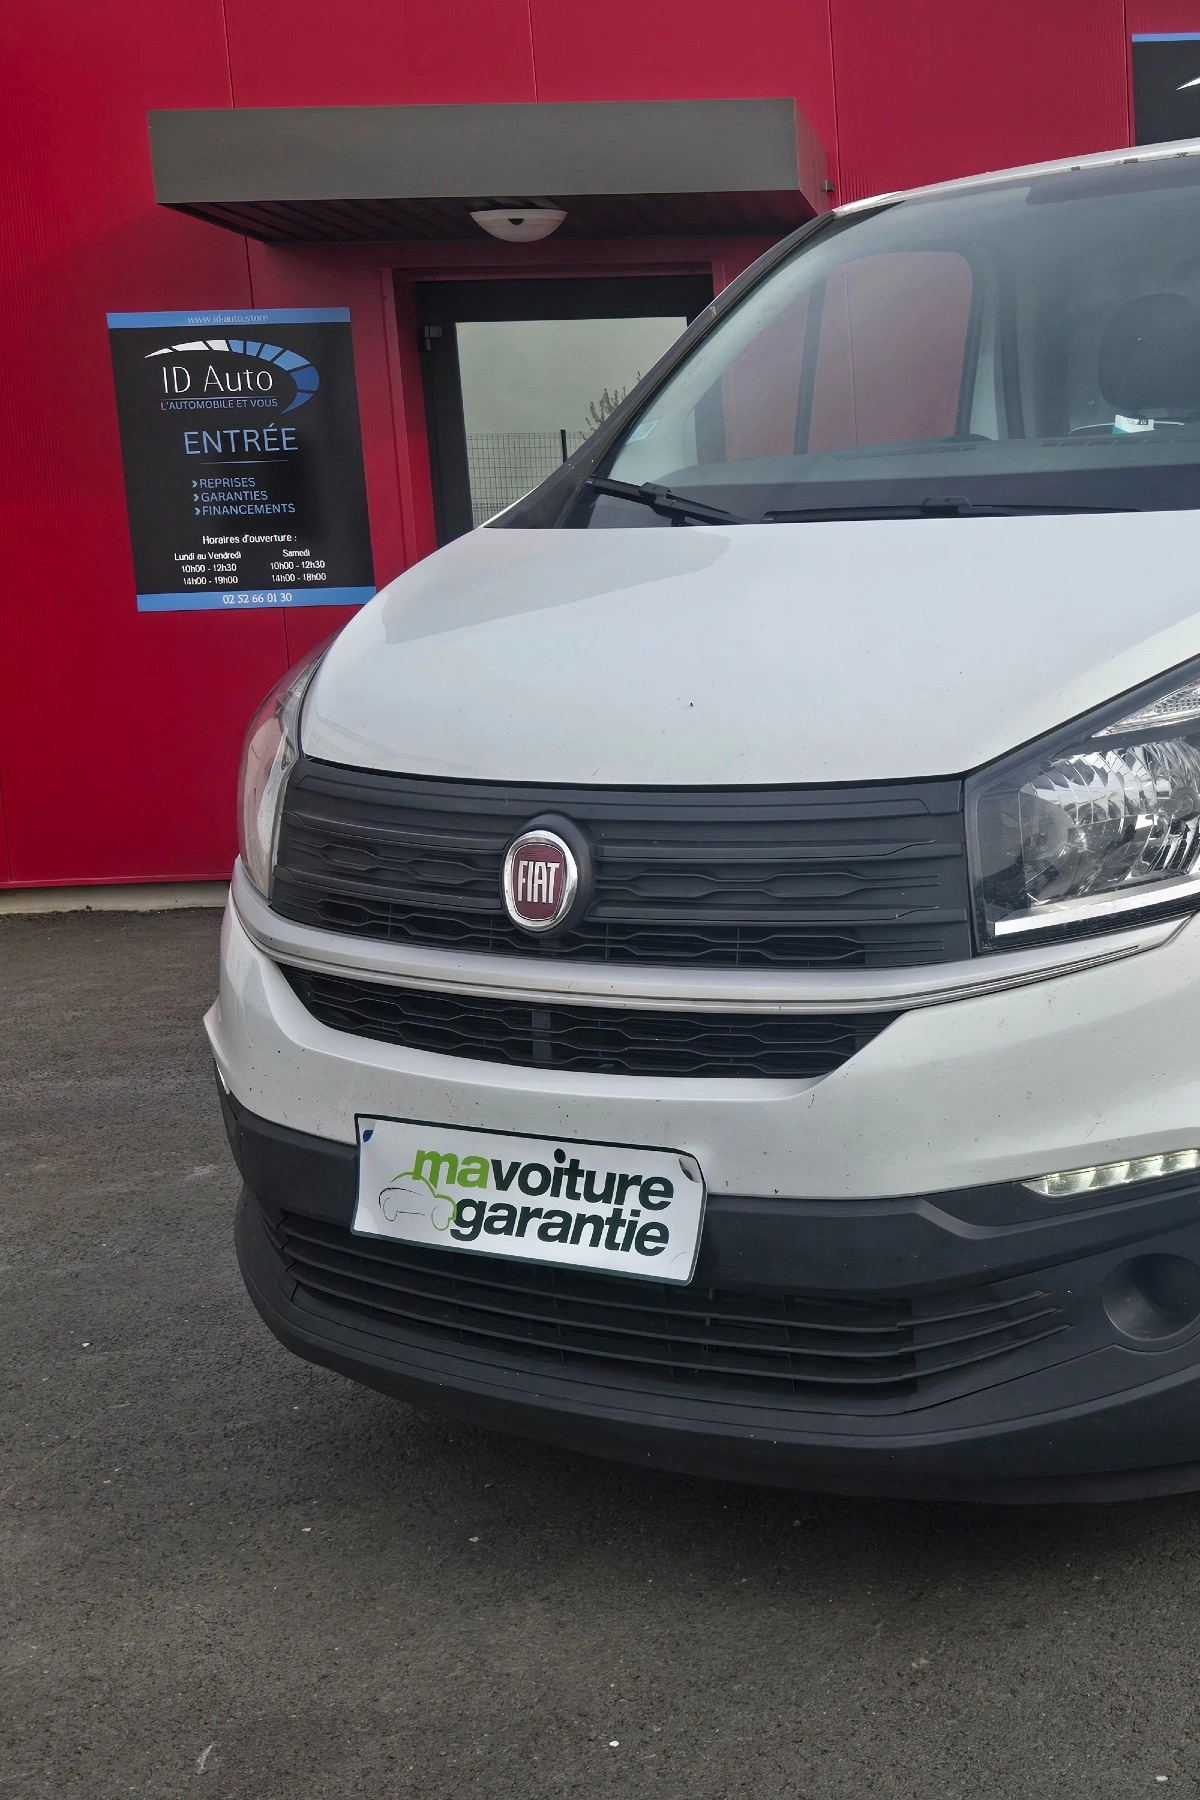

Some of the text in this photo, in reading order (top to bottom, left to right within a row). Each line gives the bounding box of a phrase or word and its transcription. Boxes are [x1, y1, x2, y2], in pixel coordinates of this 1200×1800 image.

[163, 365, 273, 393] ID Auto
[161, 398, 278, 411] L'AUTOMOBILE ET VOUS
[183, 422, 299, 455] ENTRÉE
[200, 477, 256, 489] REPRISES
[201, 490, 269, 503] GARANTIES
[202, 502, 296, 516] FINANCEMENTS
[202, 535, 240, 545] Horaires
[242, 534, 292, 544] d'ouverture
[174, 552, 195, 561] Lundi
[207, 551, 242, 560] Vendredi
[282, 549, 310, 558] Samedi
[181, 564, 206, 573] 10h00
[213, 563, 237, 572] 12h30
[270, 561, 294, 570] 10h00
[301, 560, 326, 569] 12h30
[183, 577, 207, 586] 14h00
[214, 575, 239, 585] 19h00
[271, 574, 296, 583] 14h00
[303, 572, 327, 582] 18h00
[222, 592, 293, 605] 02 52 66 01 30
[517, 860, 560, 904] FIAT
[412, 1148, 675, 1211] mavoiture
[450, 1197, 670, 1257] garantie
